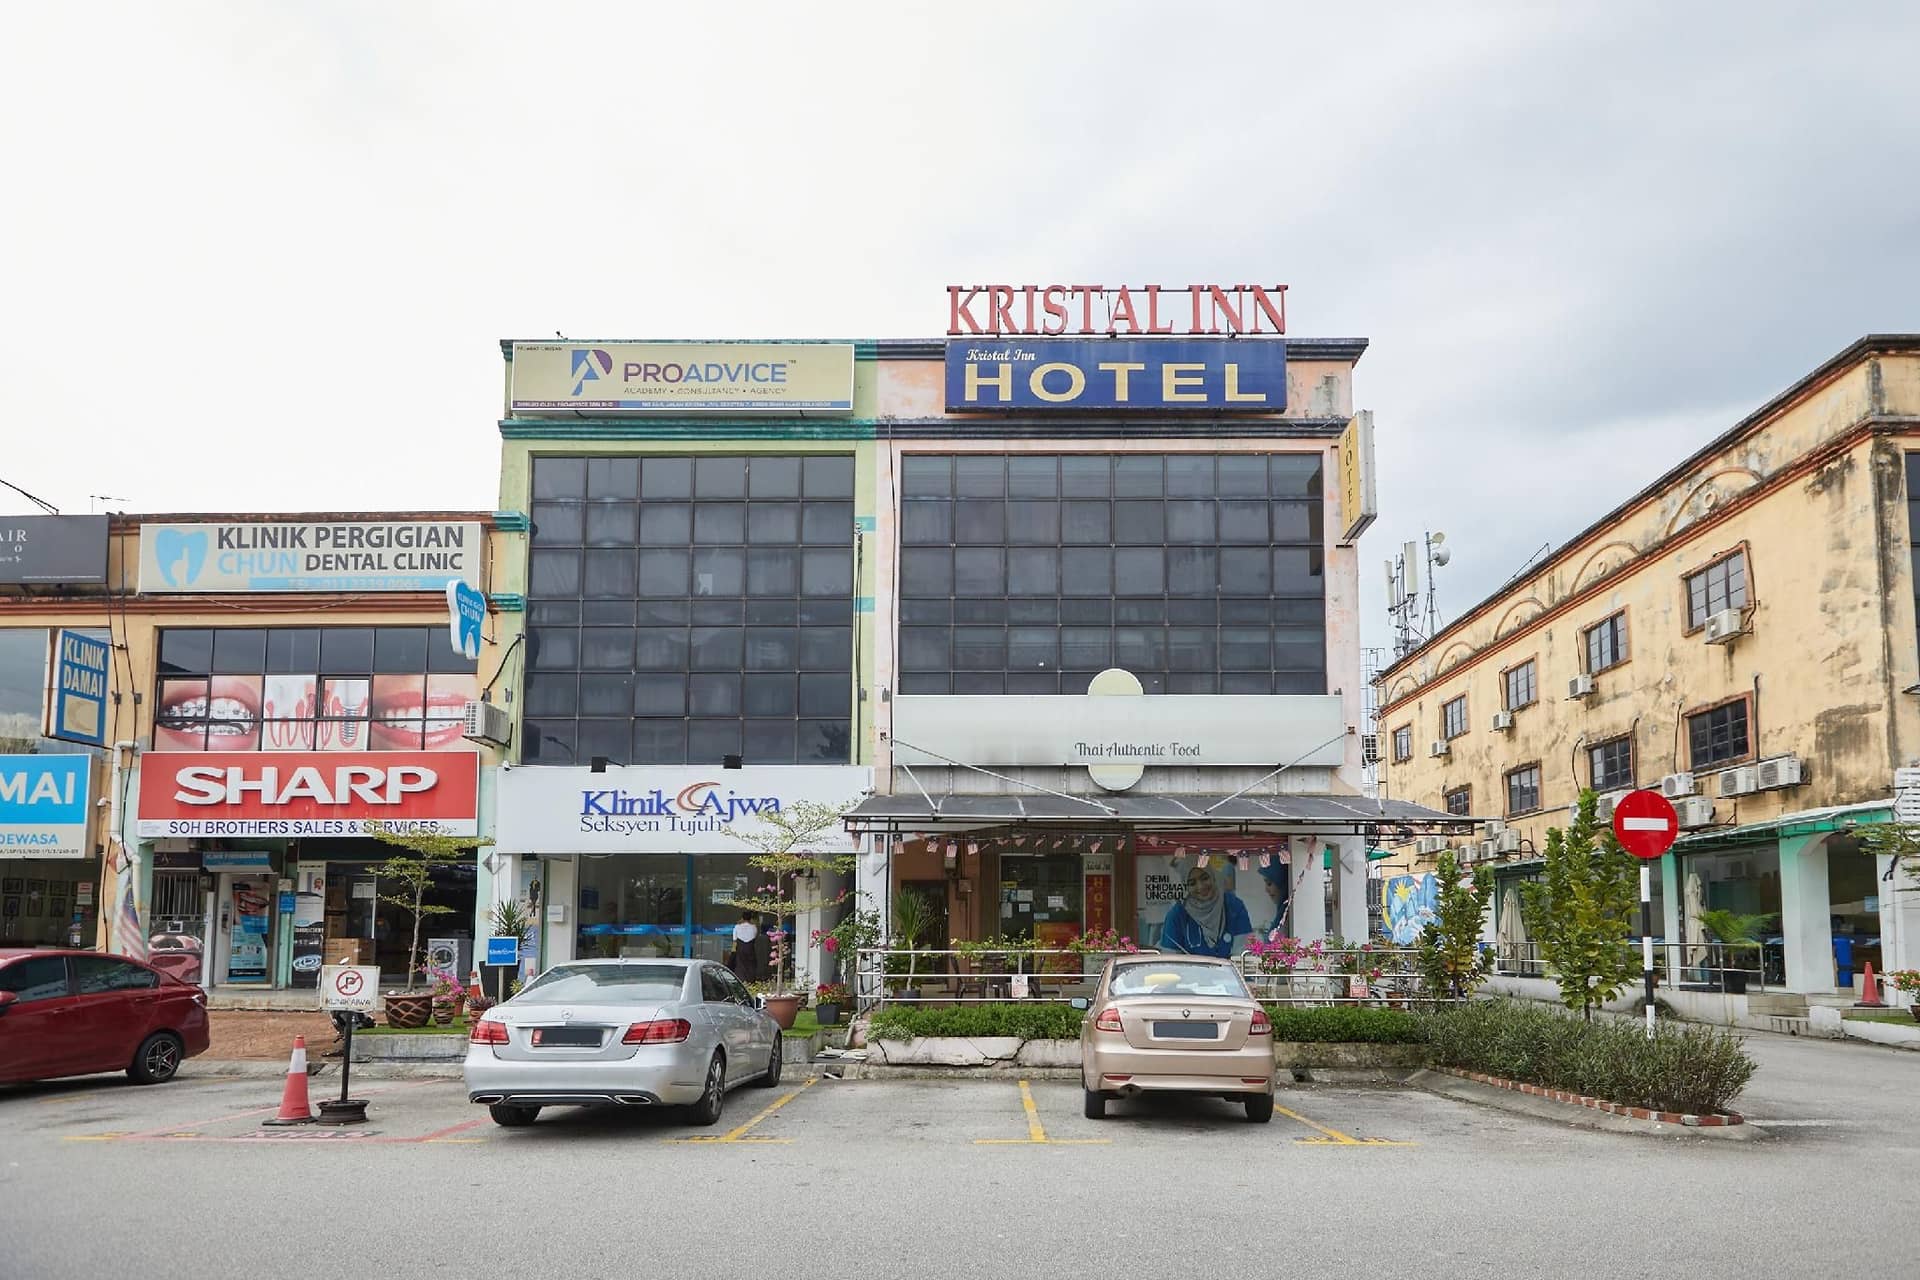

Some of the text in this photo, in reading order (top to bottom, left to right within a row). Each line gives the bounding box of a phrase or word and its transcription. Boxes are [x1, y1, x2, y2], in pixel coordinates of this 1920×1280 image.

[947, 284, 1289, 336] KRISTAL INN
[966, 348, 1036, 361] Kristal Inn
[623, 362, 787, 384] PROADVICE
[964, 362, 1267, 402] HOTEL
[624, 387, 668, 395] ACADEMY
[750, 387, 787, 395] AGENCY
[218, 525, 464, 549] KLINIK PERGIGIAN
[217, 551, 464, 575] CHUN DENTAL CLINIC
[63, 636, 105, 671] KLINIK
[63, 664, 104, 698] DAMAI
[1074, 742, 1201, 757] Thai Authentic Food
[174, 766, 439, 805] SHARP
[580, 789, 782, 824] Klinik Ajwa
[169, 821, 201, 834] SOH
[205, 821, 289, 834] BROTHERS
[293, 821, 343, 834] SALES
[347, 821, 358, 834] &
[363, 820, 439, 834] SERVICES
[580, 816, 722, 836] Seksyen Tujuh
[1145, 874, 1170, 884] DEMI
[1145, 883, 1188, 892] KHIDMAT
[1093, 876, 1104, 933] HOTE
[1145, 891, 1184, 901] UNGGUL
